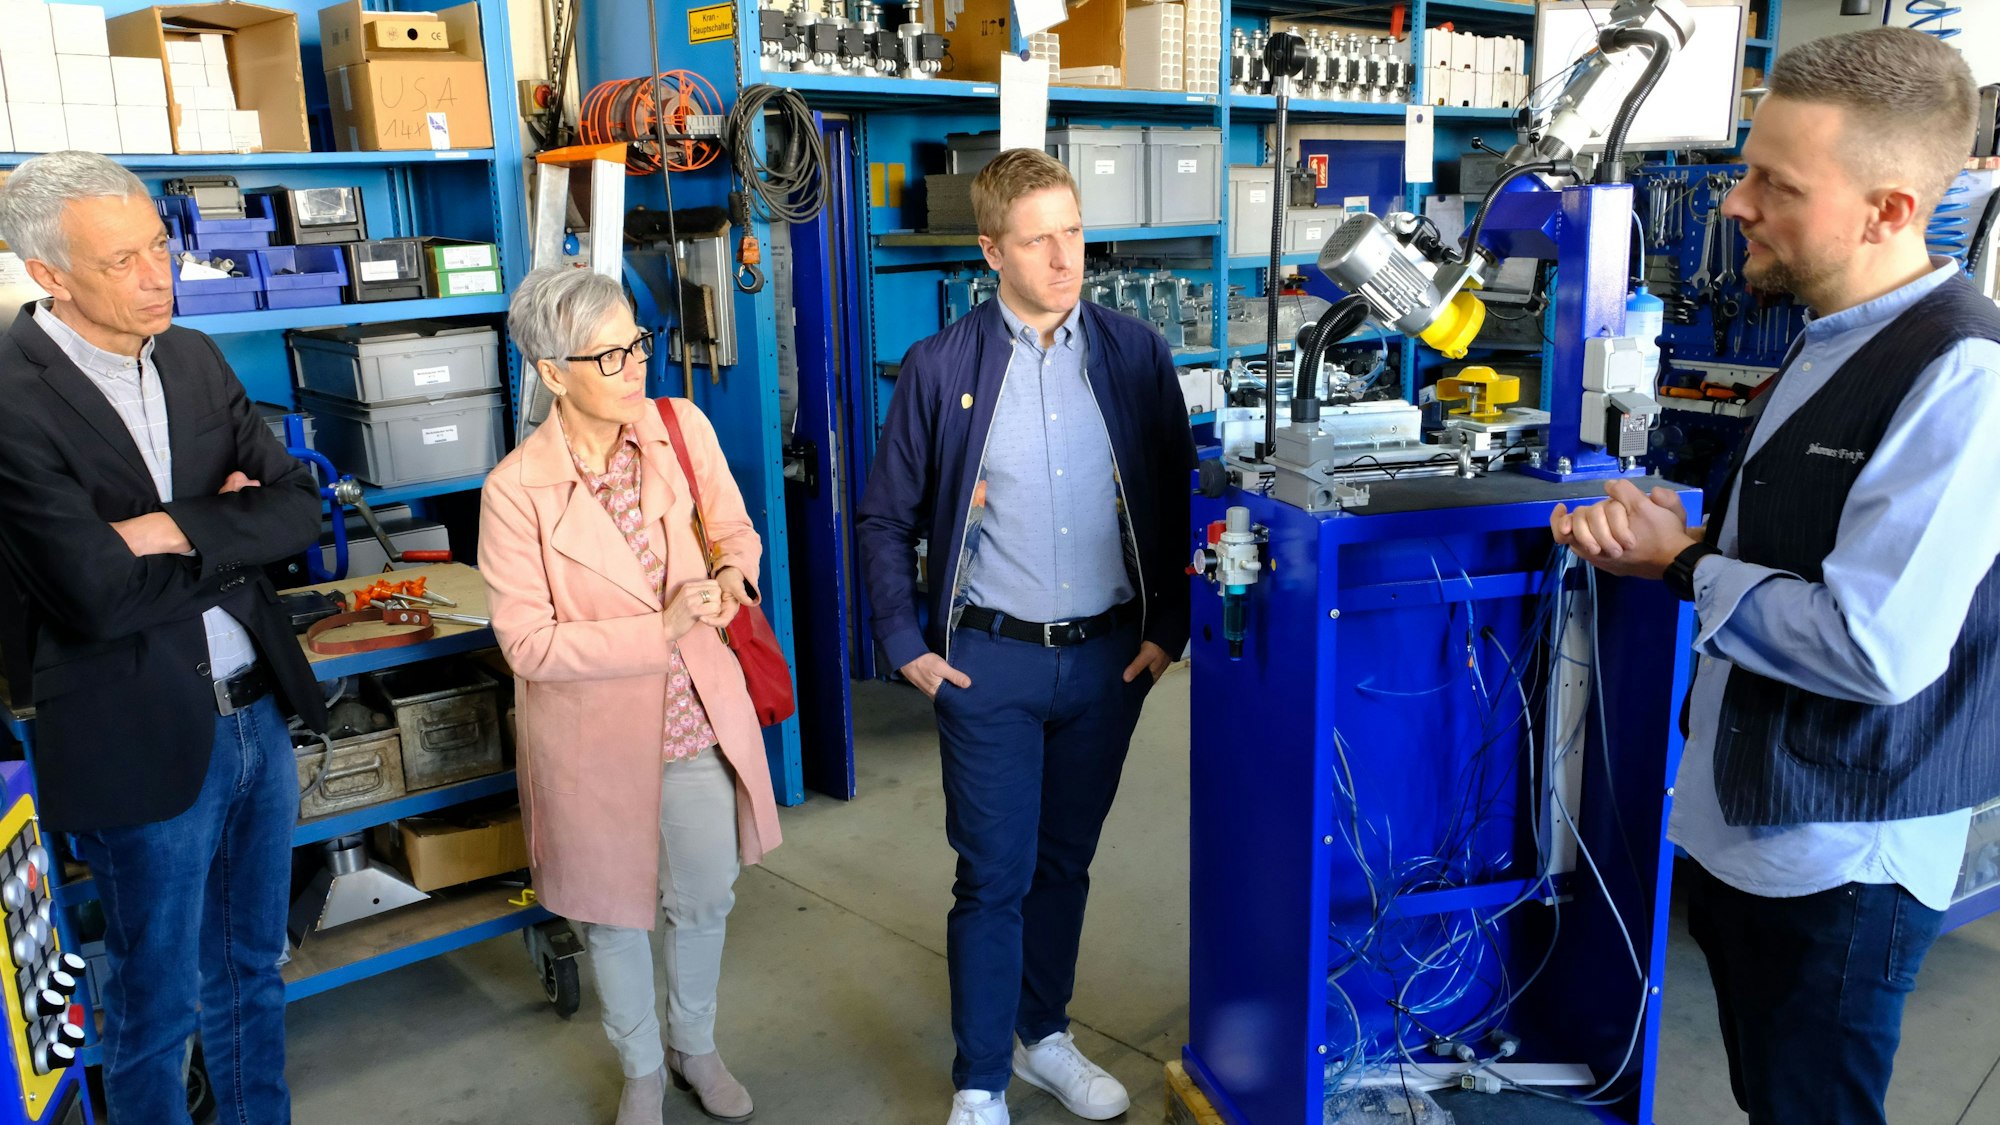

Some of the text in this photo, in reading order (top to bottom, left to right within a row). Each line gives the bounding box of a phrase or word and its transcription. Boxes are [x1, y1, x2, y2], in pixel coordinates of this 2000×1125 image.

[702, 14, 715, 22] Kran
[692, 22, 731, 35] Hauptschalter
[431, 31, 442, 41] CE
[379, 75, 458, 112] USA
